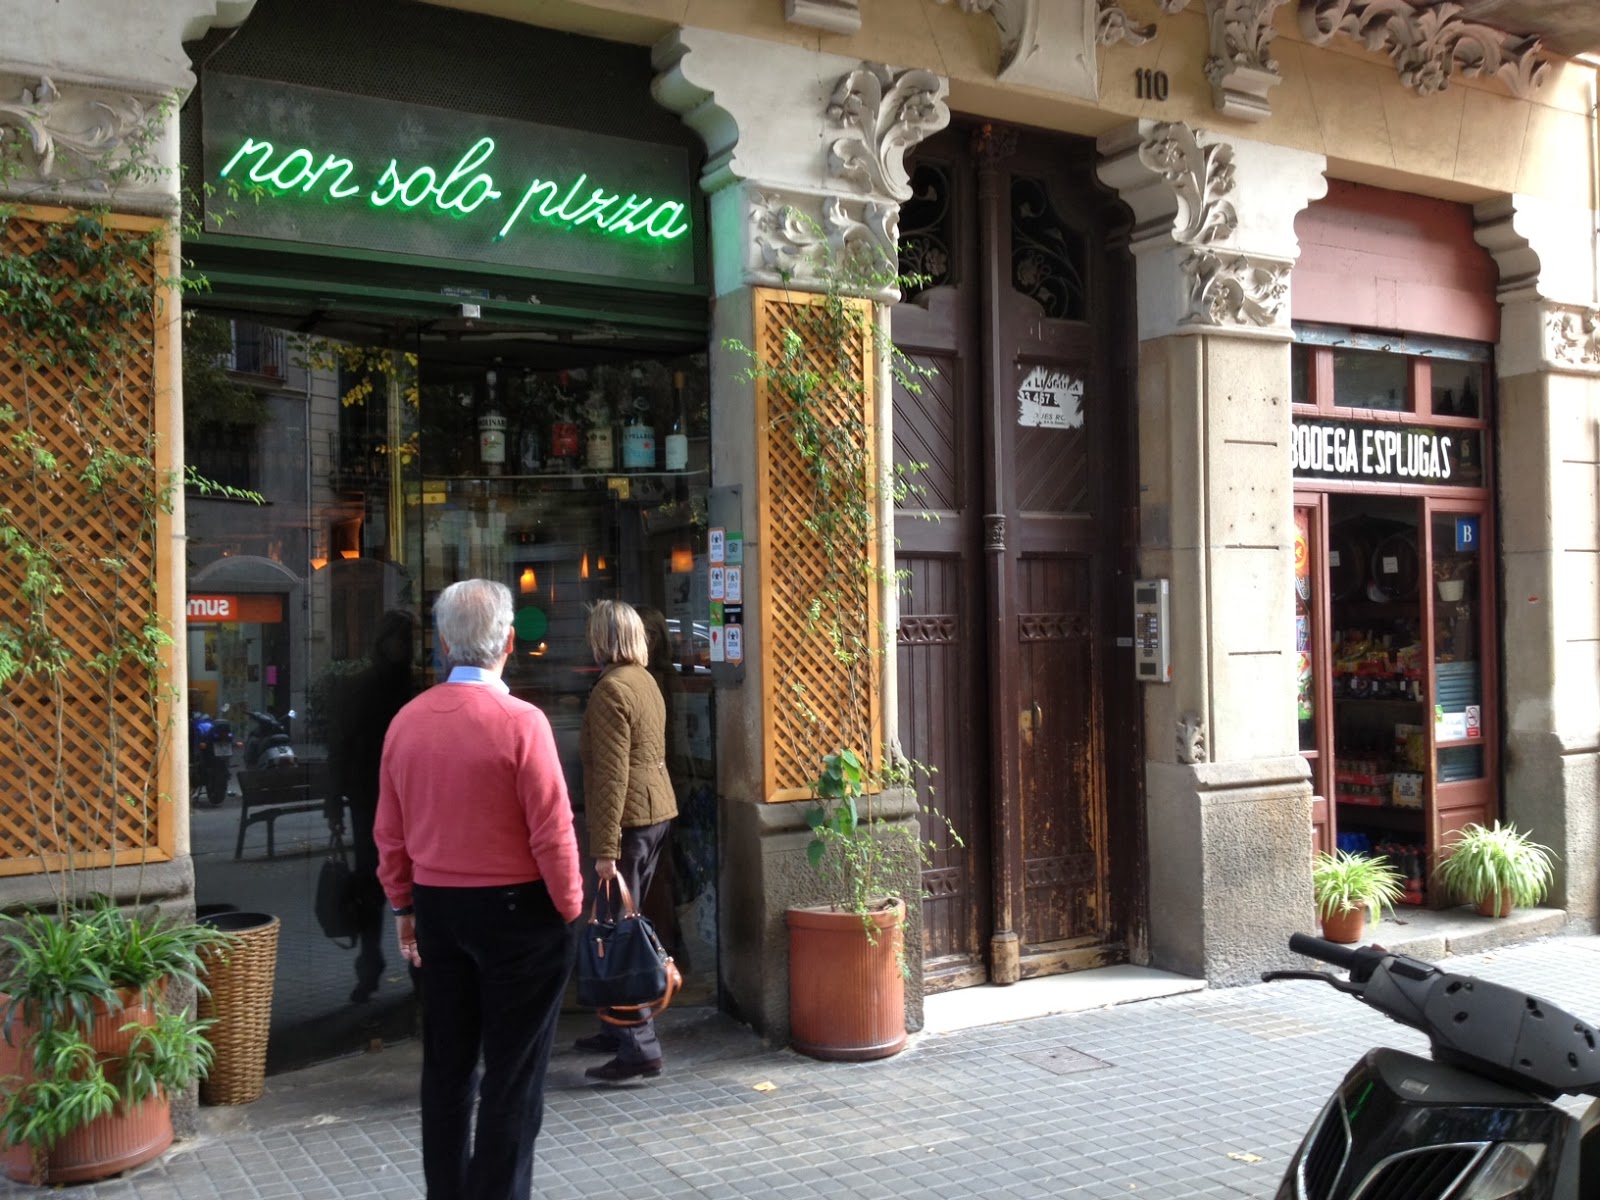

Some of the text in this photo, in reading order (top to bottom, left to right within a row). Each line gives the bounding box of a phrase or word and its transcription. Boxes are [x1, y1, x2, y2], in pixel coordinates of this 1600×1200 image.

[1135, 67, 1169, 101] 110
[220, 136, 688, 239] non solo pizza
[1291, 424, 1451, 479] BODEGA ESPLUGAS
[1463, 525, 1473, 542] B
